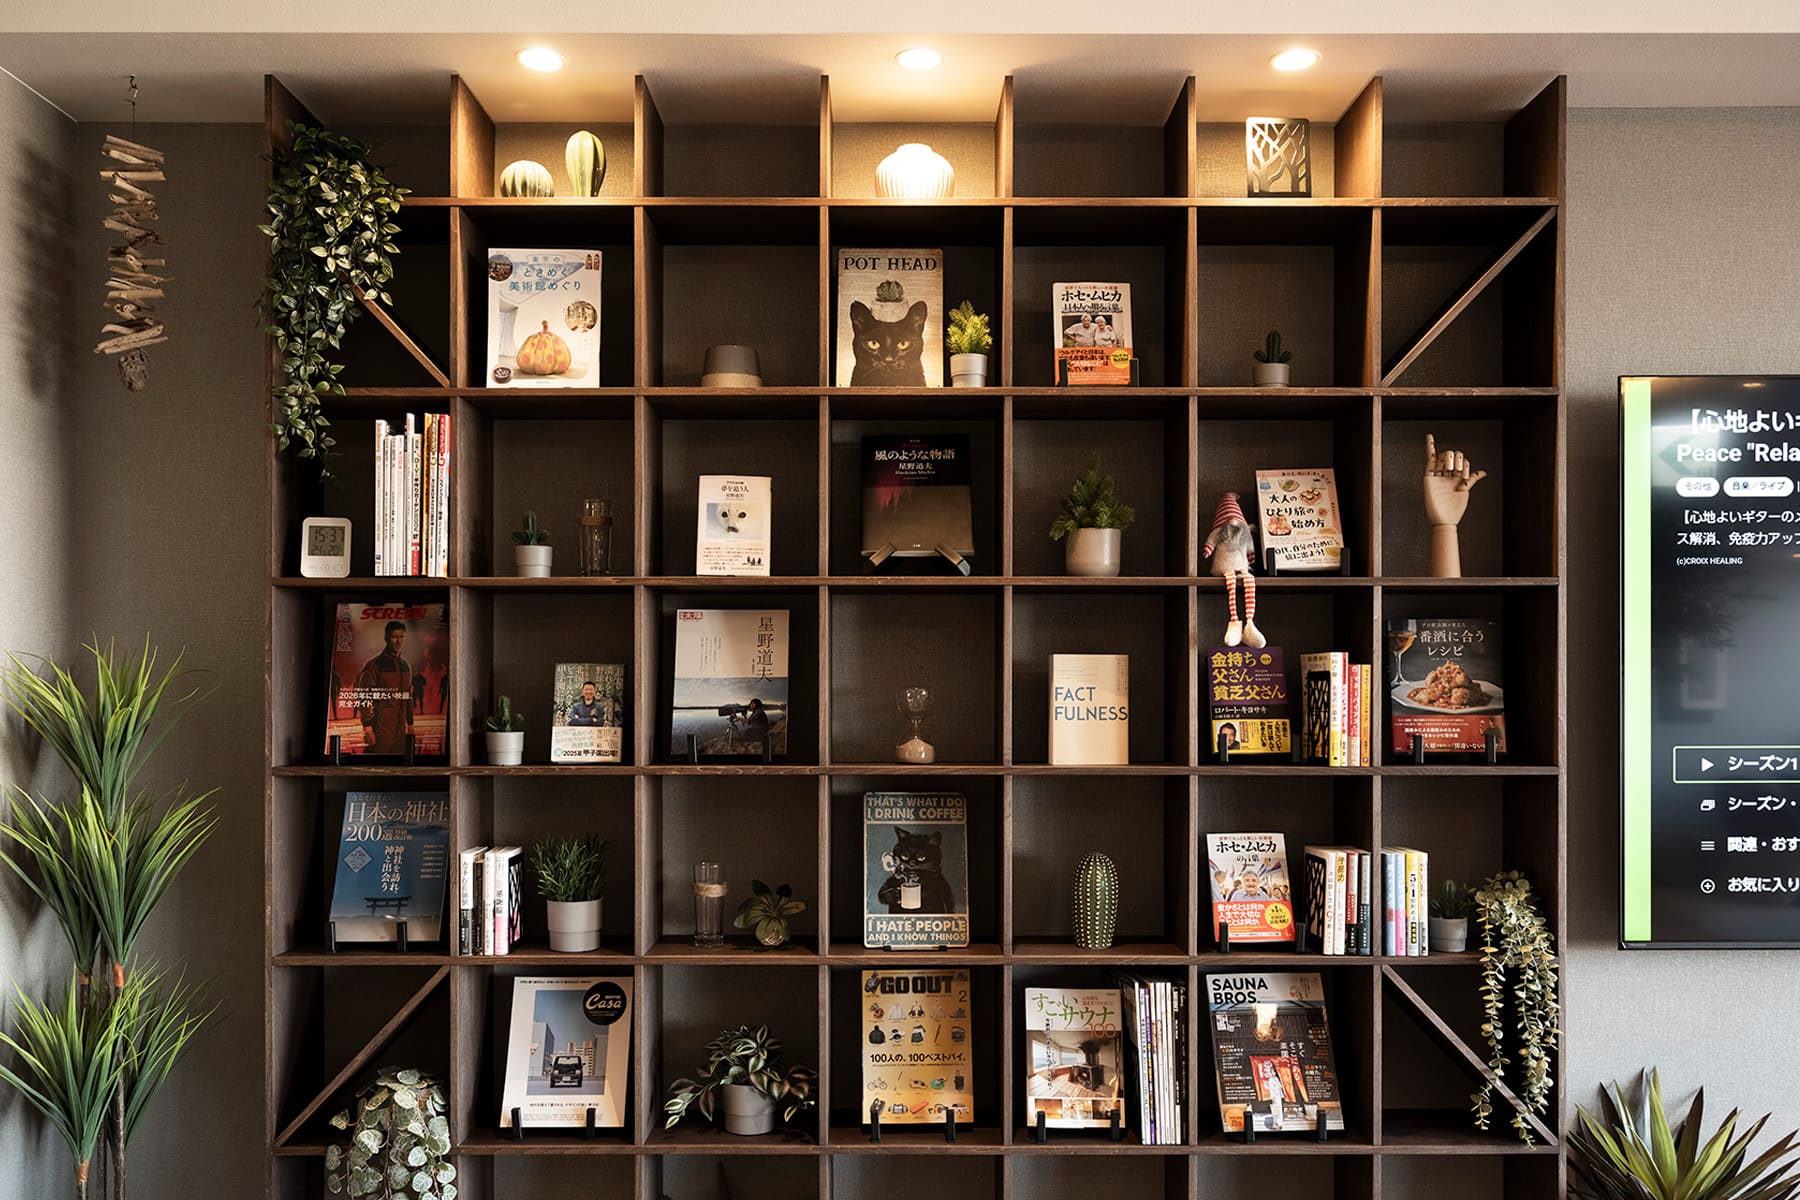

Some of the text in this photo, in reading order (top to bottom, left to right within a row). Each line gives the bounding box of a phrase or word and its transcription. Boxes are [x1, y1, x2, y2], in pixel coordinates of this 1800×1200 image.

[843, 257, 937, 271] POT HEAD
[523, 268, 568, 278] ときめく
[510, 281, 581, 291] 美術館めぐり
[1061, 290, 1122, 302] ホセ・ムヒカ
[1691, 408, 1800, 434] 【心地よい
[874, 448, 955, 461] 風のような物語
[1677, 443, 1742, 462] Peace
[1685, 481, 1712, 491] その他
[1269, 494, 1298, 504] 大人の
[1266, 506, 1315, 517] ひとり旅の
[1291, 519, 1325, 529] 始め方
[1709, 557, 1743, 565] HEALING
[360, 608, 428, 620] SCREEN
[756, 616, 774, 683] 星野道夫
[1427, 645, 1464, 657] レシピ
[1211, 652, 1257, 668] 金持ち
[1212, 668, 1254, 684] 父さん
[1054, 686, 1096, 702] FACT
[1213, 684, 1286, 701] 貧乏父さん
[338, 700, 374, 708] 完全ガイド
[1054, 706, 1129, 721] FULNESS
[1727, 755, 1798, 771] シーズン1
[867, 798, 963, 807] THAT'S WHAT I DO
[348, 800, 449, 823] 日本の神社
[867, 808, 963, 819] I DRINK COFFEE
[1216, 841, 1277, 853] ホセ・ムヒカ
[381, 845, 395, 892] 神と出会う
[1727, 877, 1800, 892] お気に入り
[868, 920, 965, 932] I HATE PEOPLE
[868, 933, 965, 941] AND I KNOW THINGS
[880, 976, 953, 994] GO OUT
[1212, 978, 1269, 991] SAUNA
[585, 993, 622, 1010] Casa
[958, 990, 967, 1002] 2
[1213, 991, 1261, 1004] BROS.
[1031, 992, 1079, 1017] すごい
[1059, 1006, 1115, 1029] サウナ
[1088, 1022, 1116, 1038] 100
